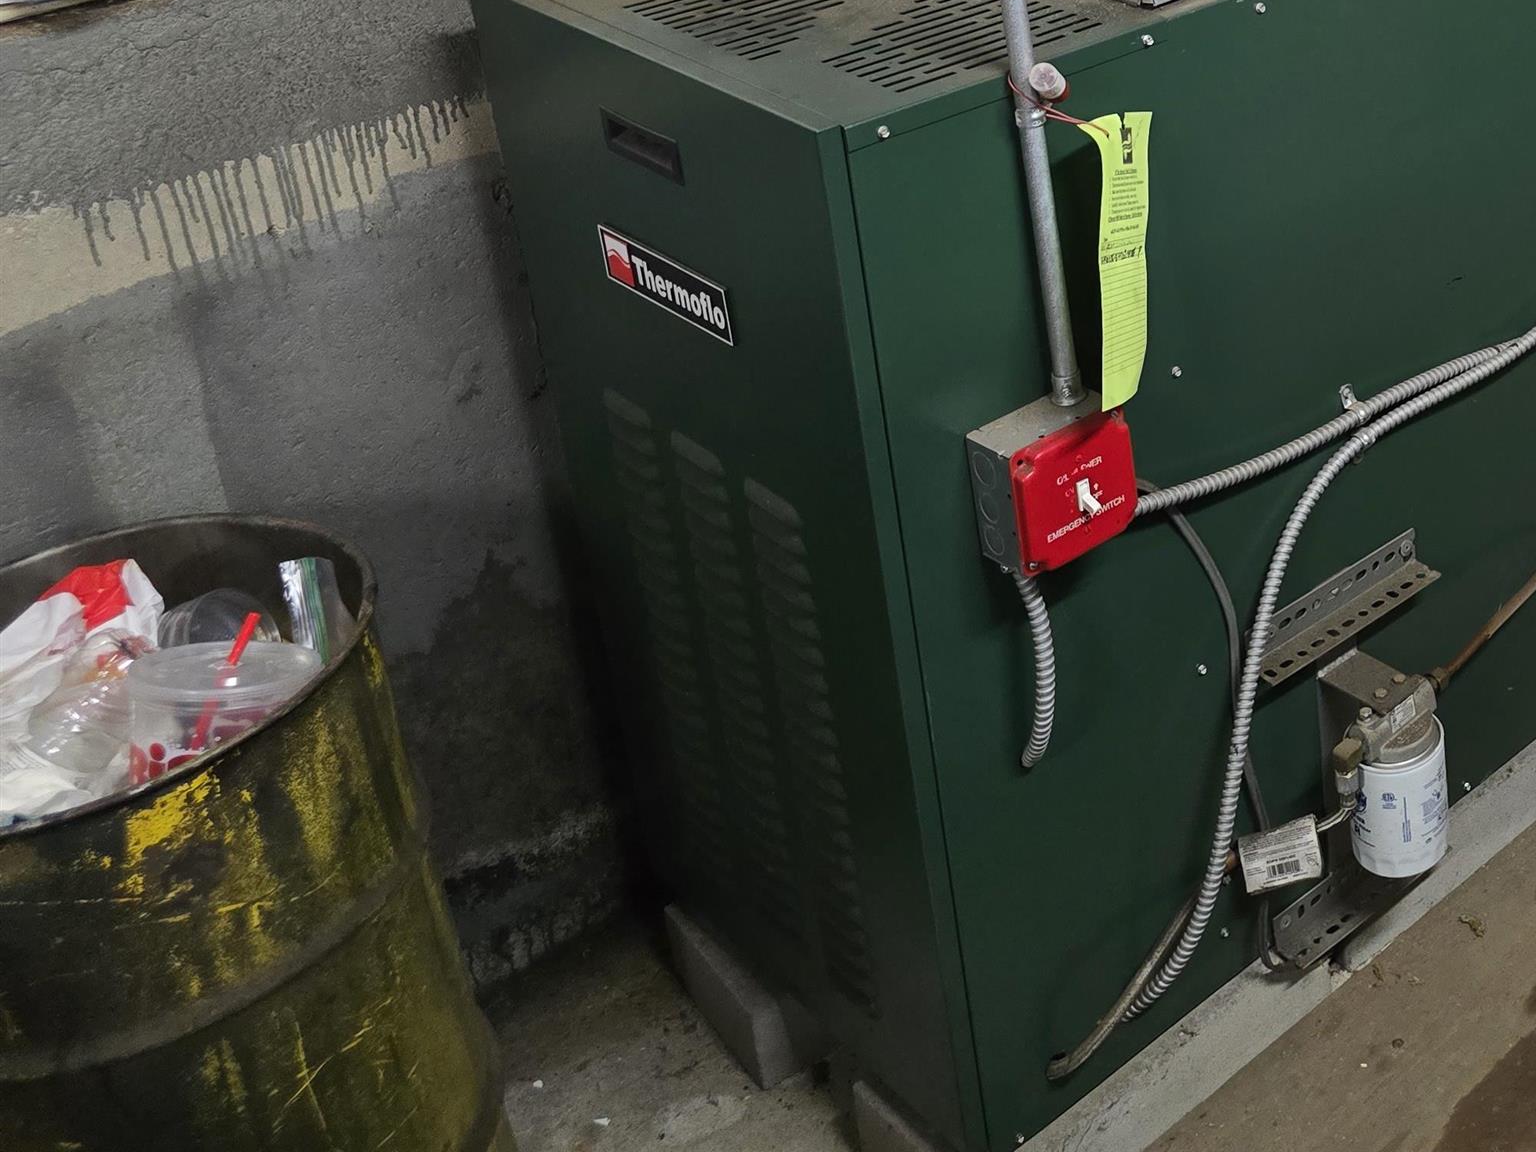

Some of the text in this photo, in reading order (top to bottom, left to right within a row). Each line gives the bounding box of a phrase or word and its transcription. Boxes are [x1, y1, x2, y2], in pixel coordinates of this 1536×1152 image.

[631, 254, 726, 330] Thermoflo
[1047, 494, 1126, 543] EMERGENCY SWITCH
